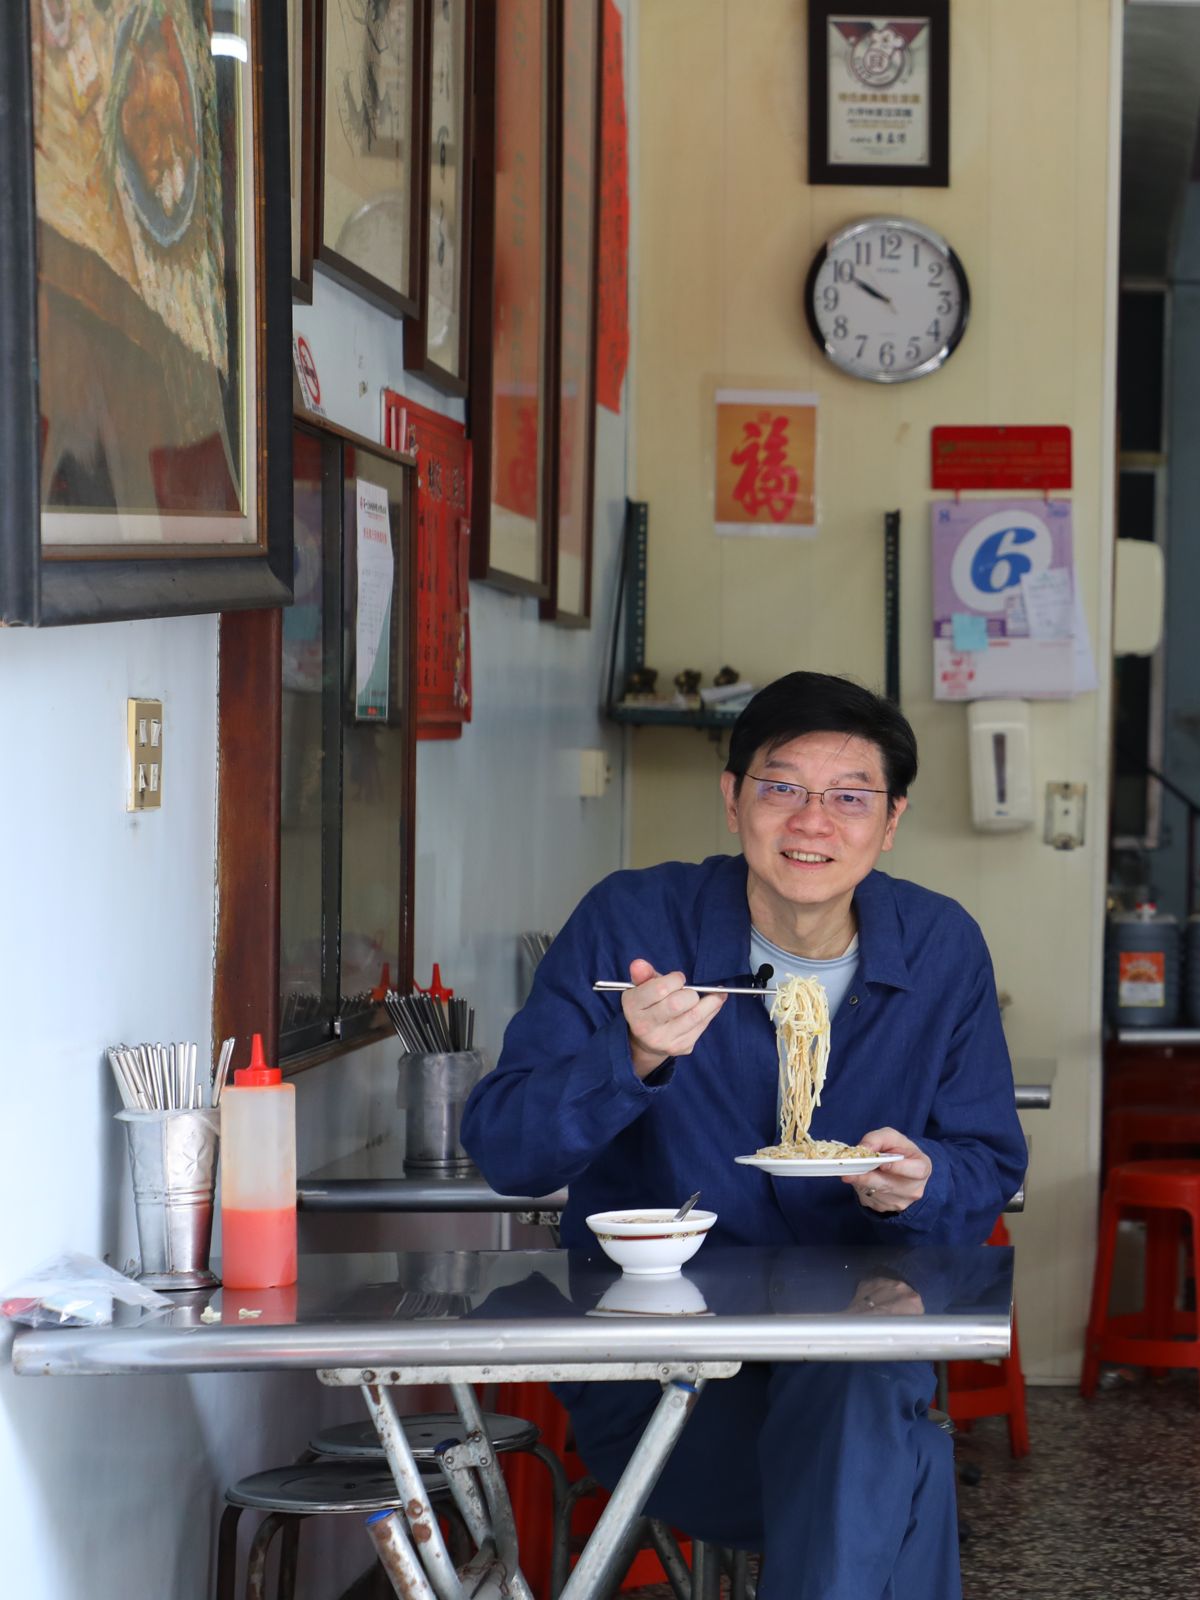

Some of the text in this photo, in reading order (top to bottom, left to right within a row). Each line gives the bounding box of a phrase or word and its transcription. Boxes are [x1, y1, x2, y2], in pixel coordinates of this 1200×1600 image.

[856, 241, 871, 266] 11
[880, 234, 902, 260] 12
[913, 243, 919, 268] 1
[833, 259, 855, 283] 10
[928, 262, 943, 287] 2
[823, 286, 839, 312] 9
[937, 290, 952, 315] 3
[833, 315, 848, 339] 8
[926, 318, 941, 342] 4
[855, 334, 868, 358] 7
[879, 342, 895, 368] 6
[905, 336, 920, 360] 5
[731, 415, 799, 523] 福
[970, 526, 1037, 593] 6
